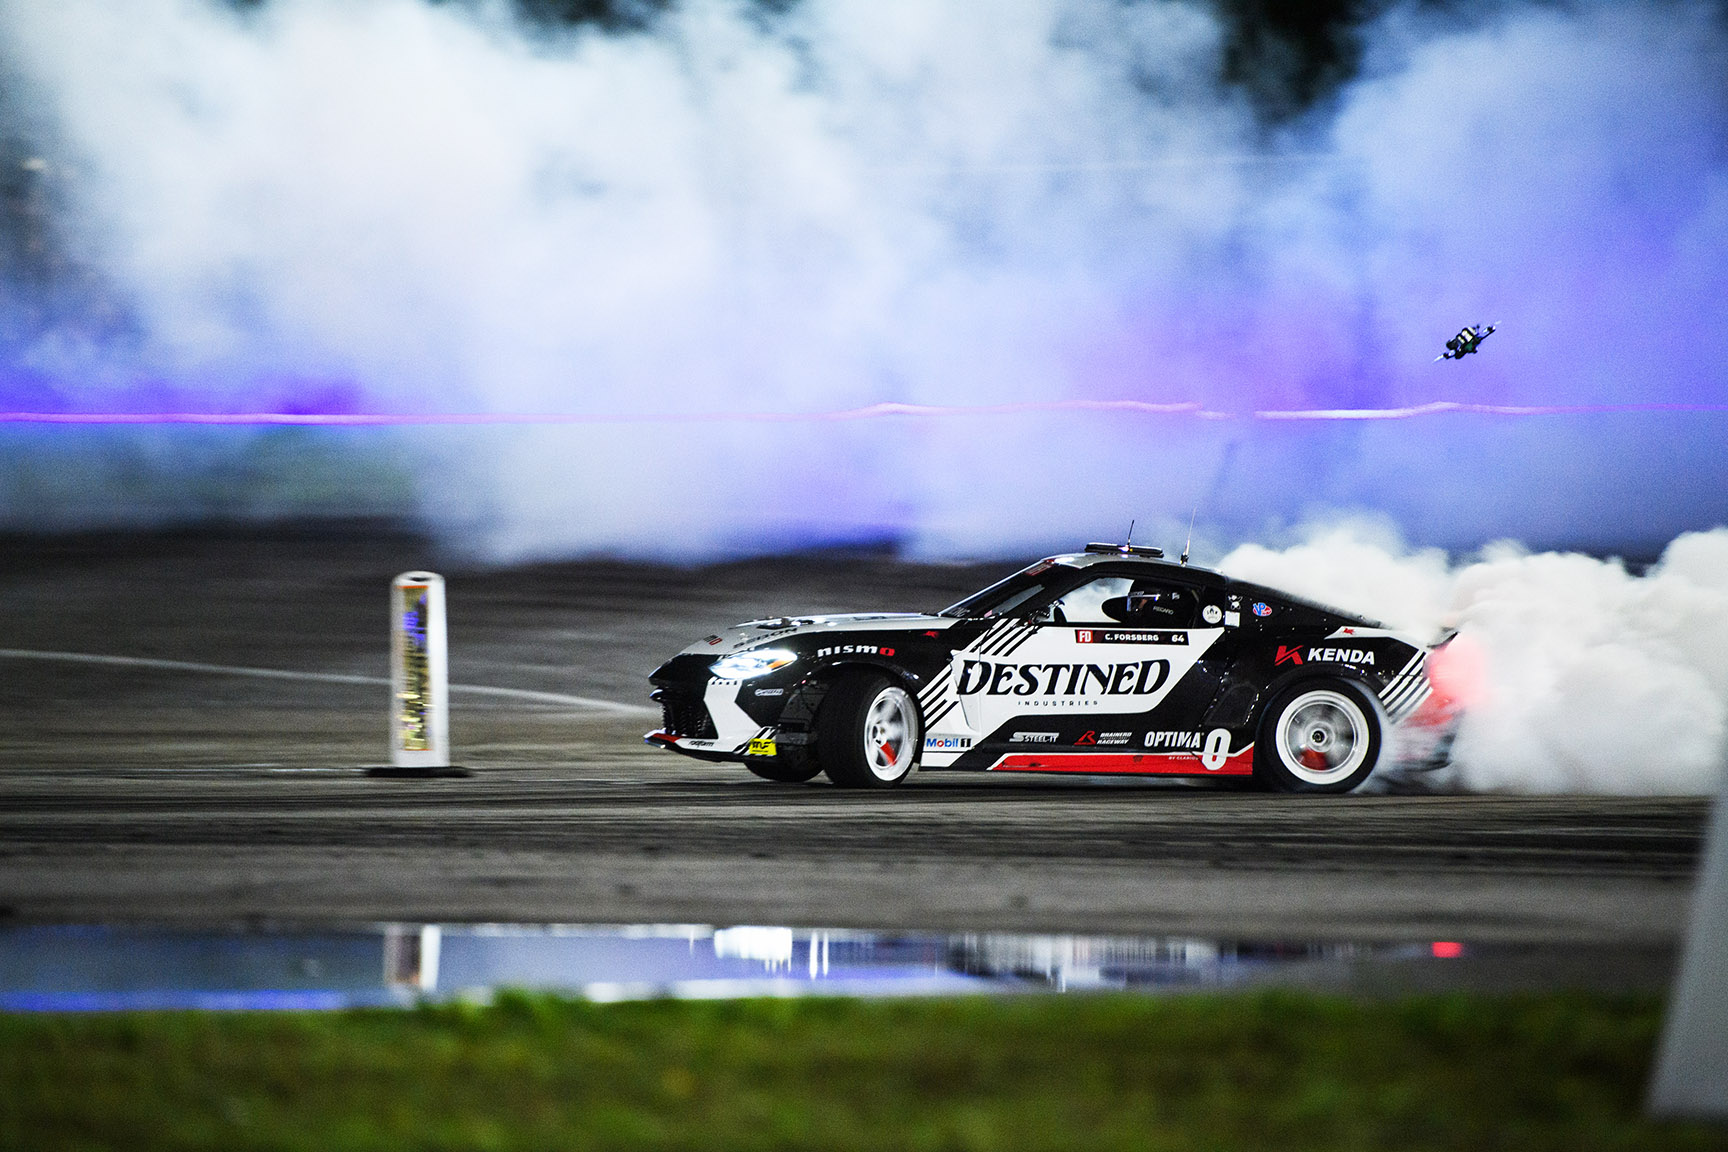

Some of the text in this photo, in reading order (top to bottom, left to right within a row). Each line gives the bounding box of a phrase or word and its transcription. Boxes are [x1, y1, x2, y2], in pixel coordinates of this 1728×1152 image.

[1079, 631, 1185, 643] FD C. FORSBERG 64
[1307, 647, 1375, 666] KENDA
[956, 658, 1170, 696] DESTINED
[926, 737, 959, 748] Mobil
[1144, 731, 1201, 748] OPTIMA
